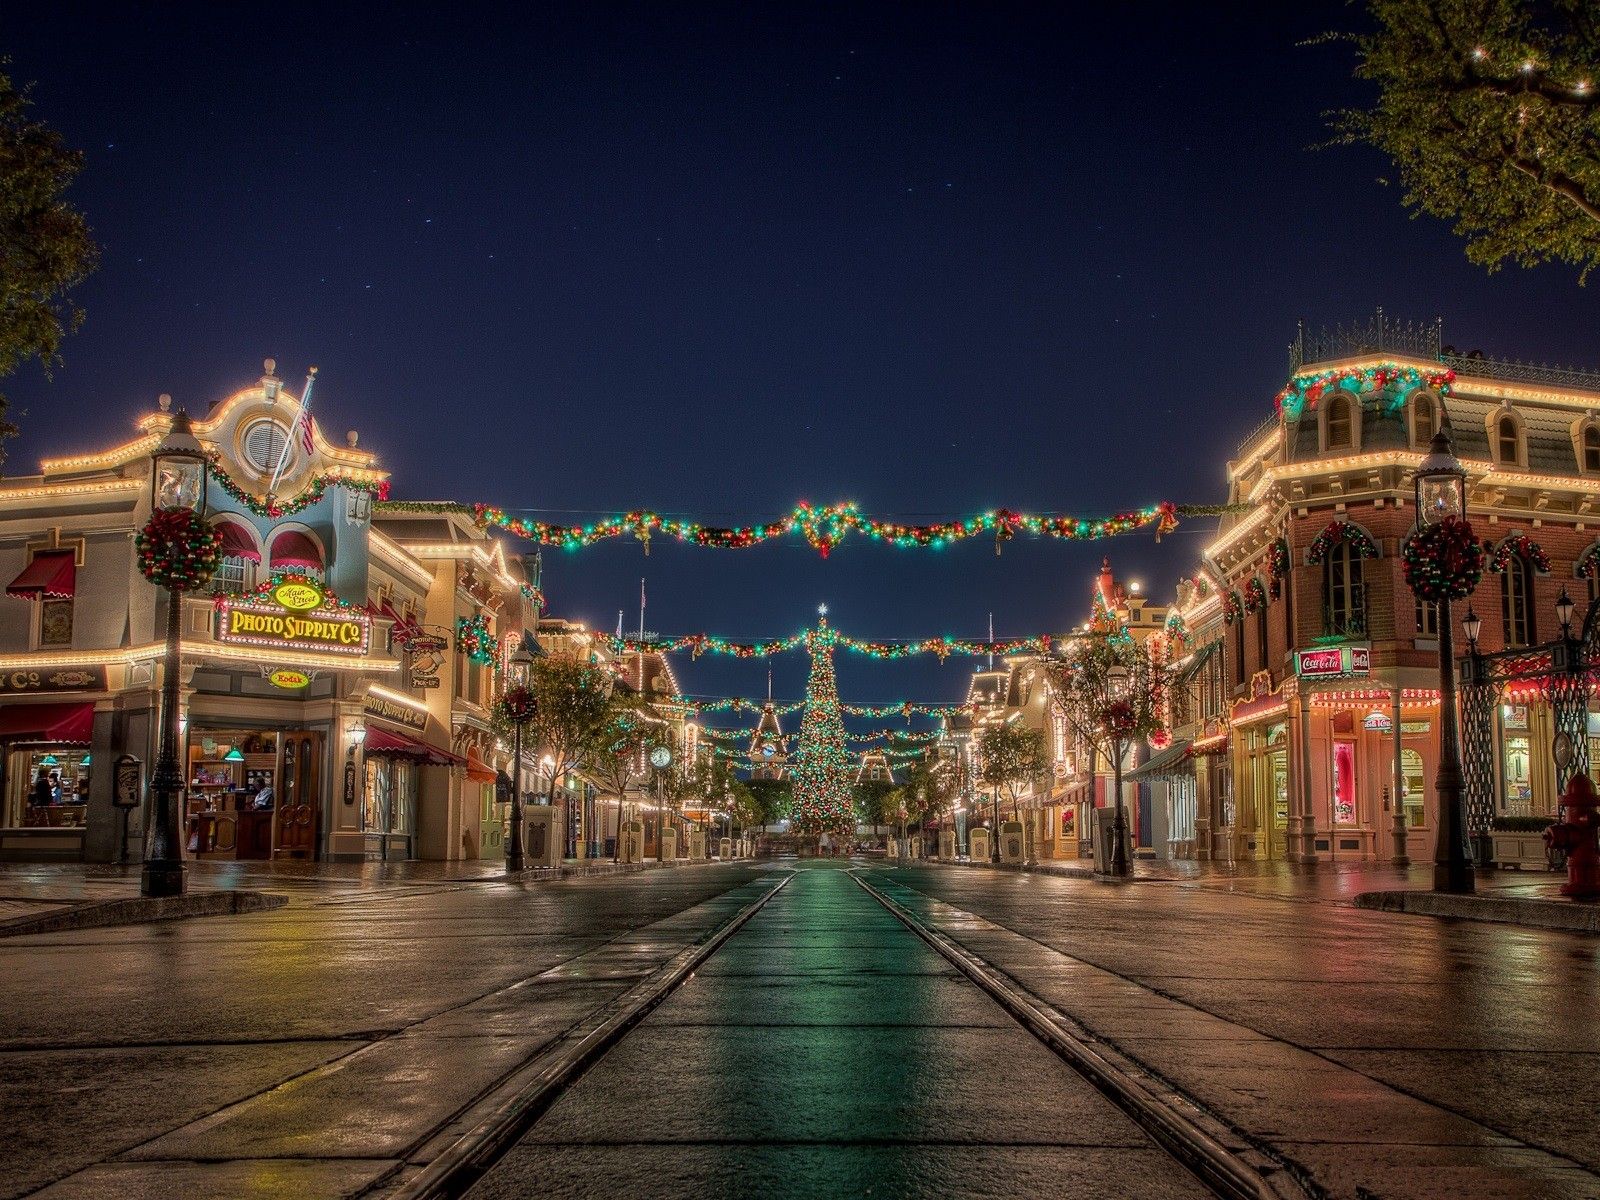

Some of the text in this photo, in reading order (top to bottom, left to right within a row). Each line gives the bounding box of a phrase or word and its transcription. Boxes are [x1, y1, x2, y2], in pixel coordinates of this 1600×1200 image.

[279, 586, 308, 599] Main
[289, 594, 316, 608] Street
[231, 610, 284, 634] PHOTO
[283, 616, 340, 639] SUPPLY
[277, 674, 303, 684] Kodak
